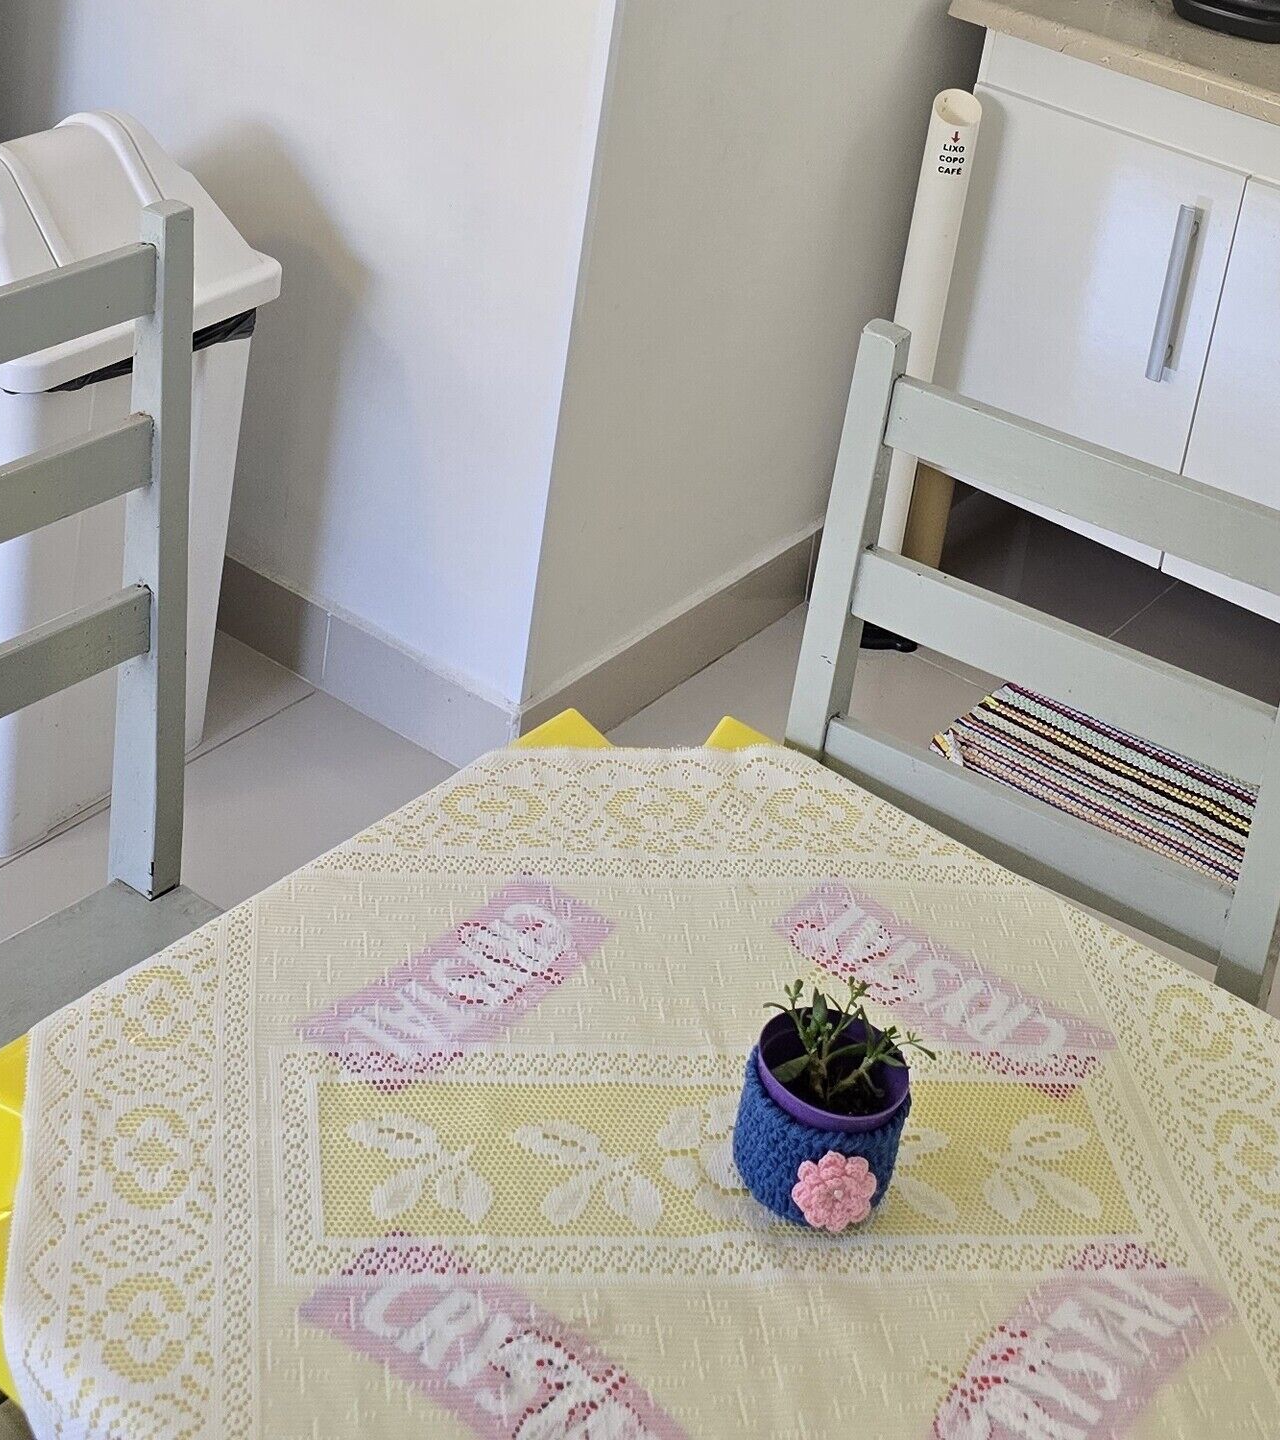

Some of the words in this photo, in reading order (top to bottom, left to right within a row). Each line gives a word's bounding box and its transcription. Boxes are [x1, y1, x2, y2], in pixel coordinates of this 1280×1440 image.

[943, 144, 965, 153] LIXO
[939, 155, 965, 164] COPO
[937, 166, 962, 175] CAFÉ
